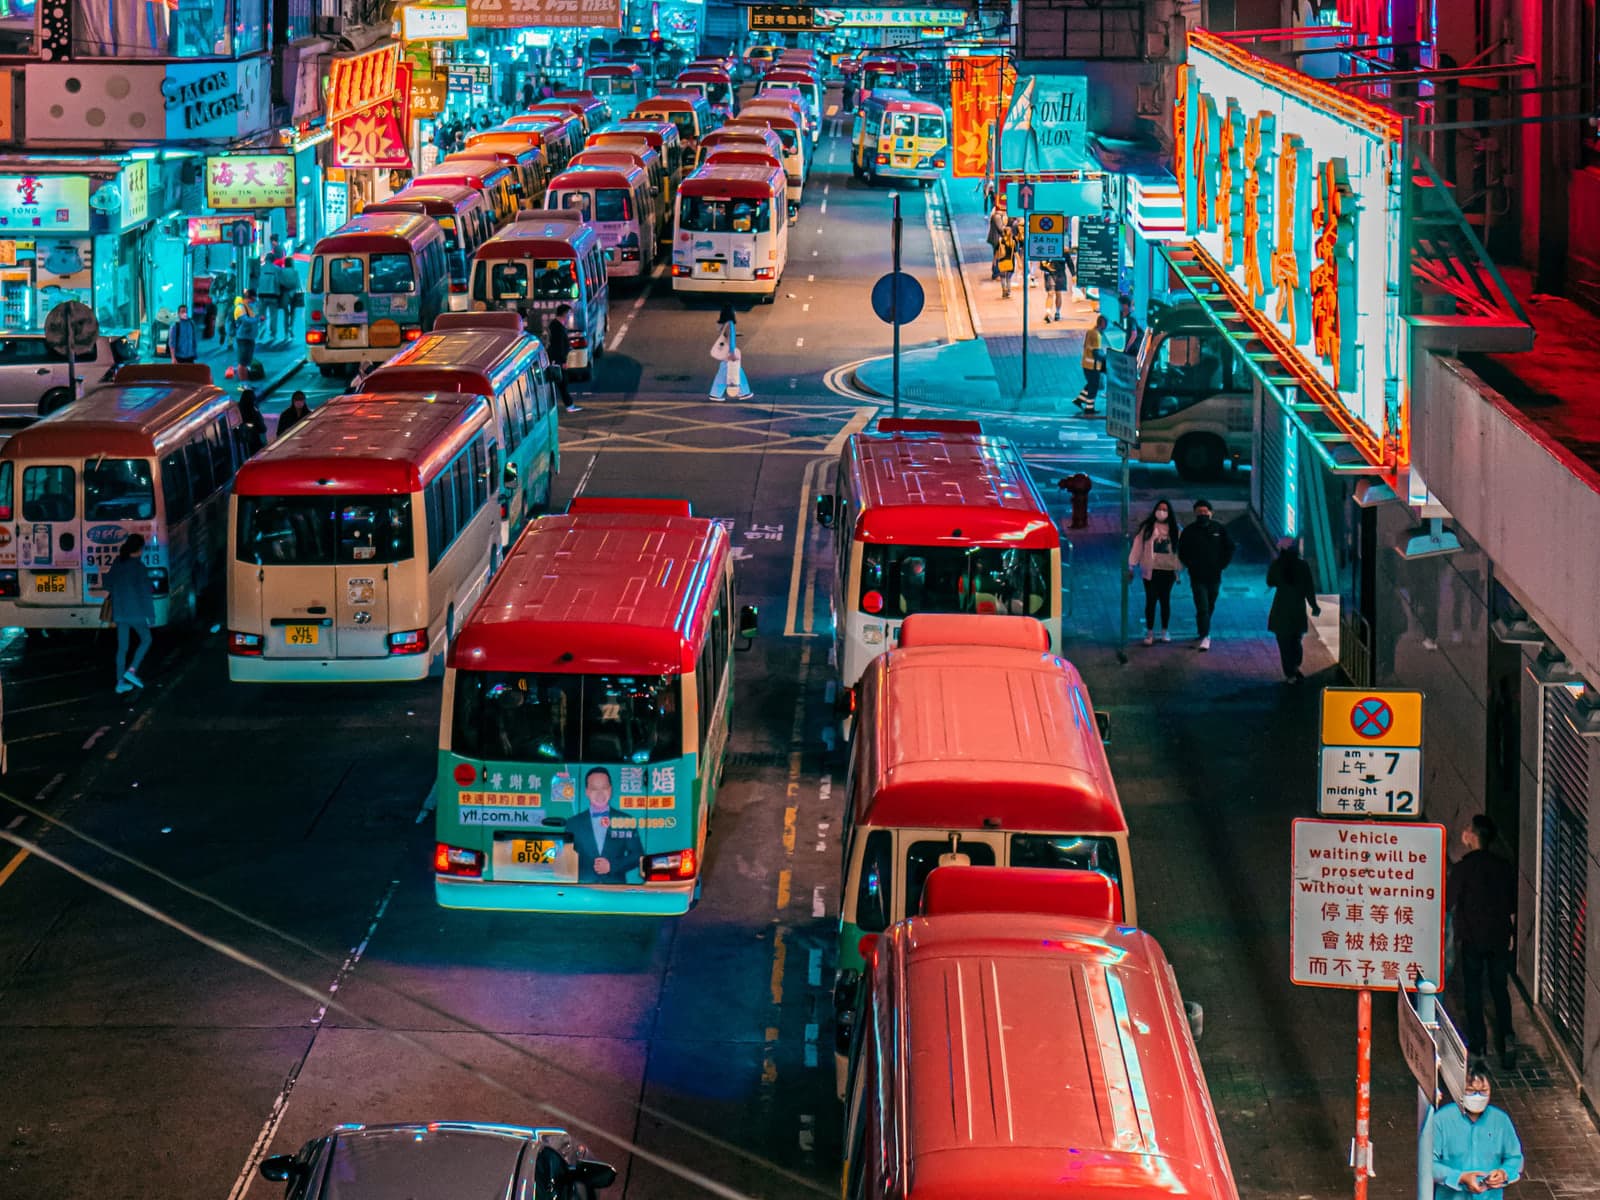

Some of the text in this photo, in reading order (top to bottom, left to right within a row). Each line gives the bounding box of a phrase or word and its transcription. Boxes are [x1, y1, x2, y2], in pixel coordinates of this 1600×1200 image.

[161, 71, 230, 111] SALON
[185, 93, 249, 130] MORE
[348, 130, 381, 156] 20
[1039, 130, 1073, 146] ALON
[12, 207, 39, 215] TONG
[1033, 235, 1060, 244] 24 hrs
[295, 626, 310, 636] VH
[291, 634, 313, 644] 975
[1344, 750, 1361, 758] am
[1338, 760, 1367, 775] 上午
[1384, 752, 1400, 775] 7
[1326, 785, 1378, 797] midnight
[1337, 798, 1367, 812] 午夜
[1385, 790, 1413, 813] 12
[1338, 830, 1398, 845] Vehicle
[524, 840, 543, 852] EN
[1309, 847, 1428, 864] waiting will be
[1321, 866, 1415, 880] prosecuted
[1299, 880, 1435, 900] without warning
[1320, 901, 1415, 925] 停車等候
[1321, 930, 1414, 953] 會被檢控
[1308, 956, 1425, 982] 而不予警告
